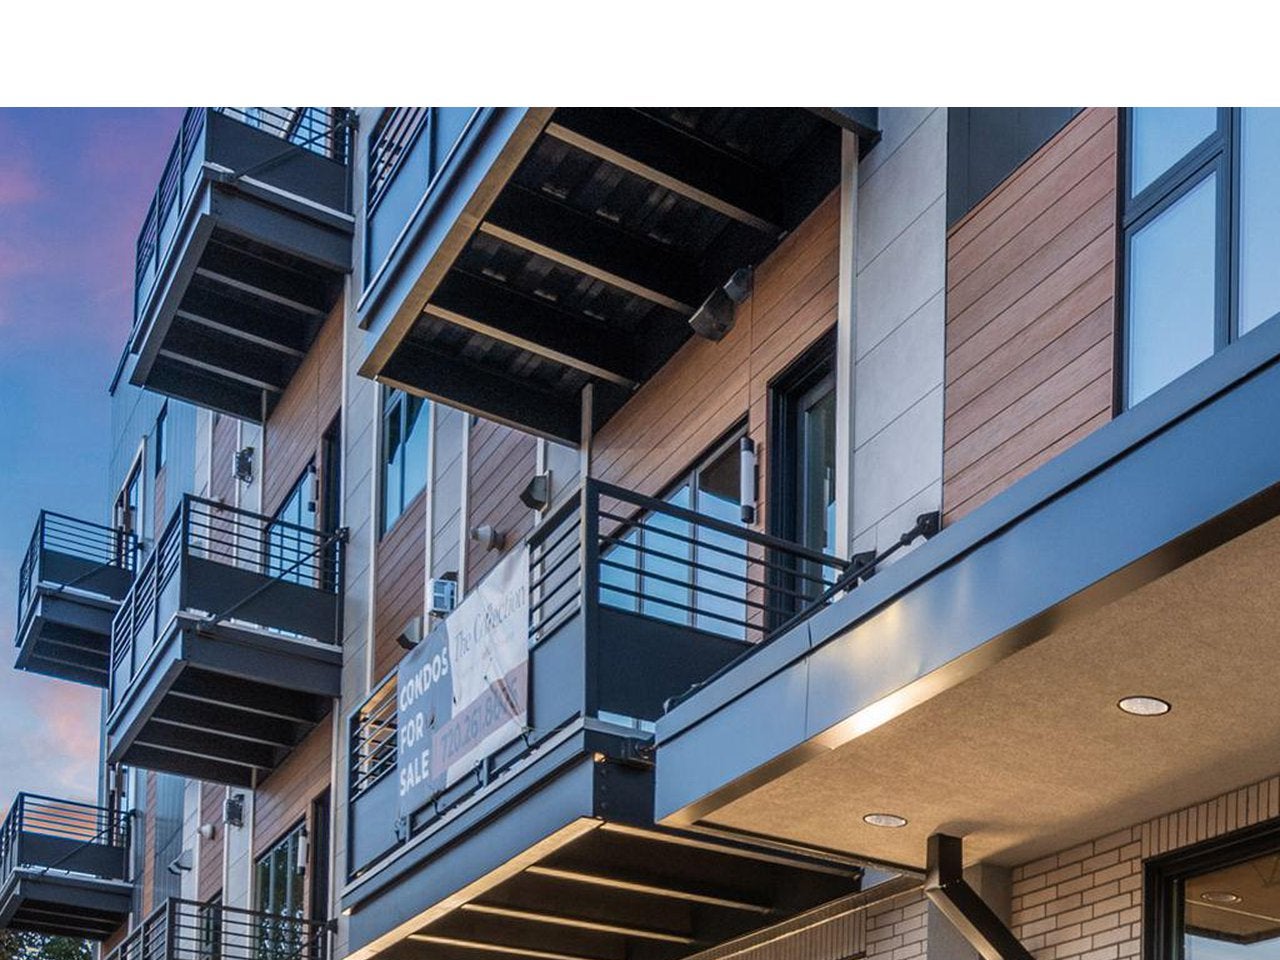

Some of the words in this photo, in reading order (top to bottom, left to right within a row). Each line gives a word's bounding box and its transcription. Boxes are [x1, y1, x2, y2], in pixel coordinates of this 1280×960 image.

[400, 647, 449, 711] CONDOS
[401, 711, 424, 755] FOR
[400, 749, 430, 796] SALE
